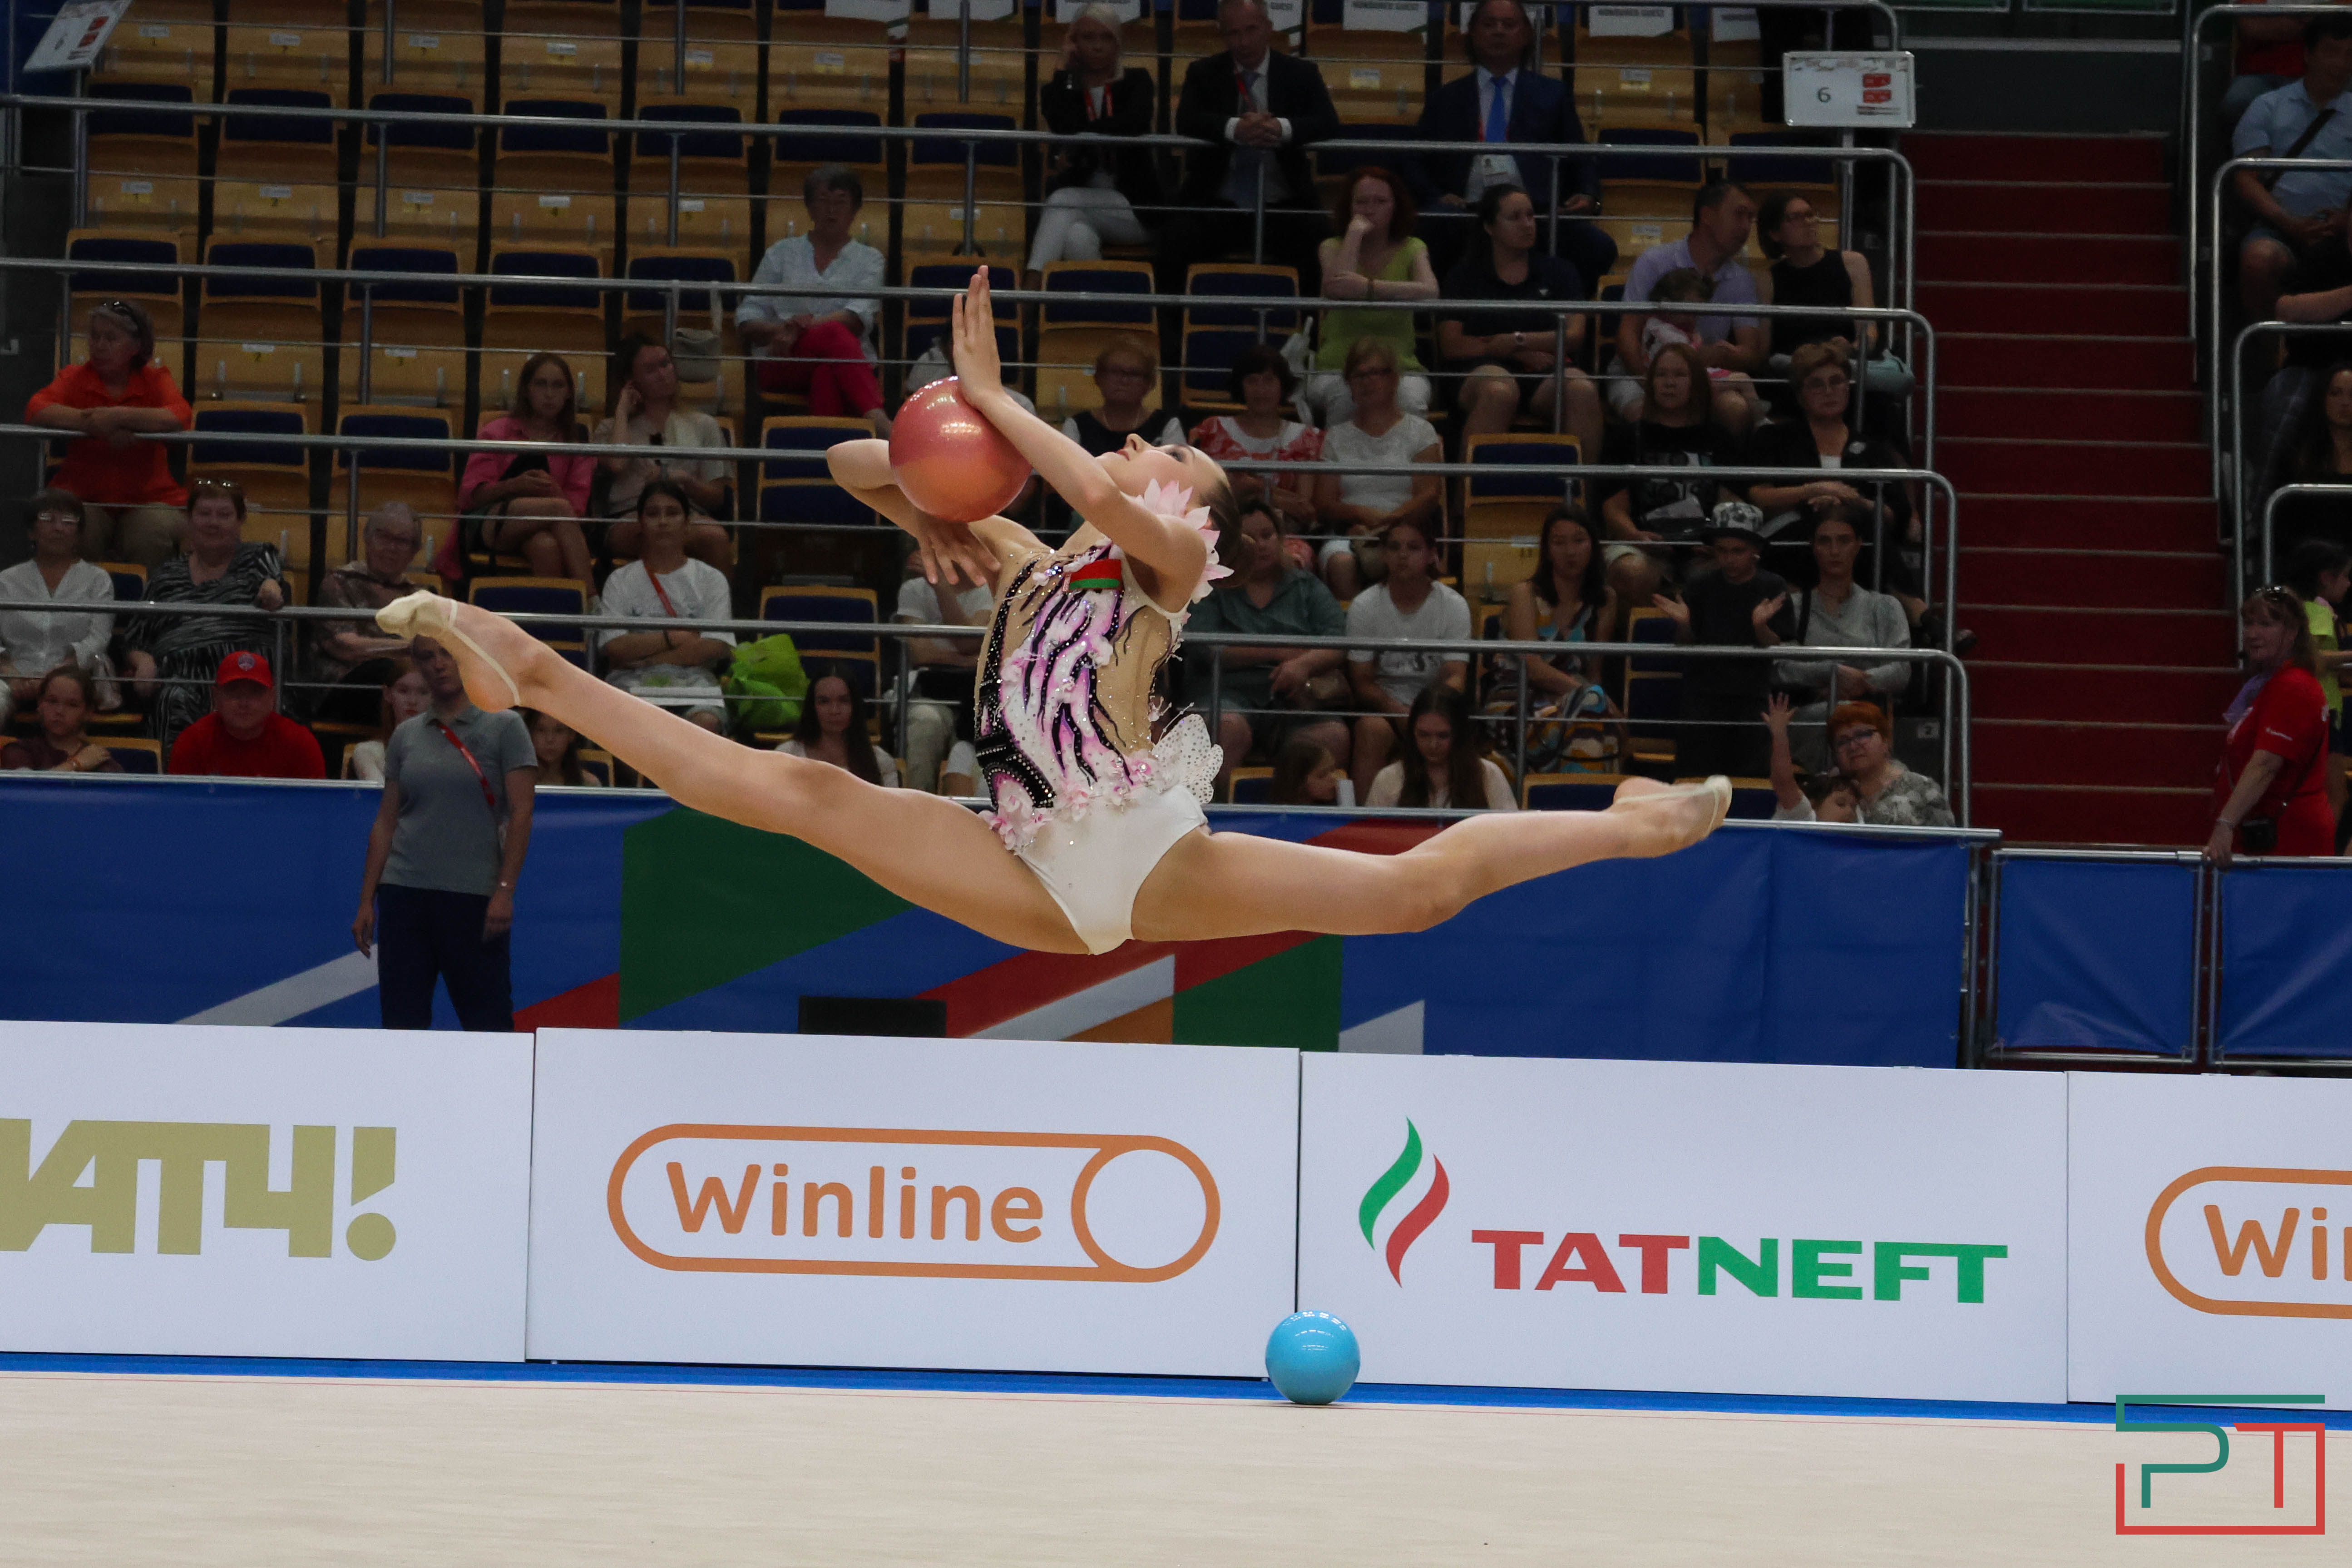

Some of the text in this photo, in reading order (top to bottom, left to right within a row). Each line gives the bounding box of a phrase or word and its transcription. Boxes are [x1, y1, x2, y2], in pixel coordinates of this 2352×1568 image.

[1817, 87, 1831, 103] 6
[666, 1162, 1043, 1243] Winline
[1473, 1230, 2007, 1303] TATNEFT
[2203, 1204, 2352, 1282] Wi
